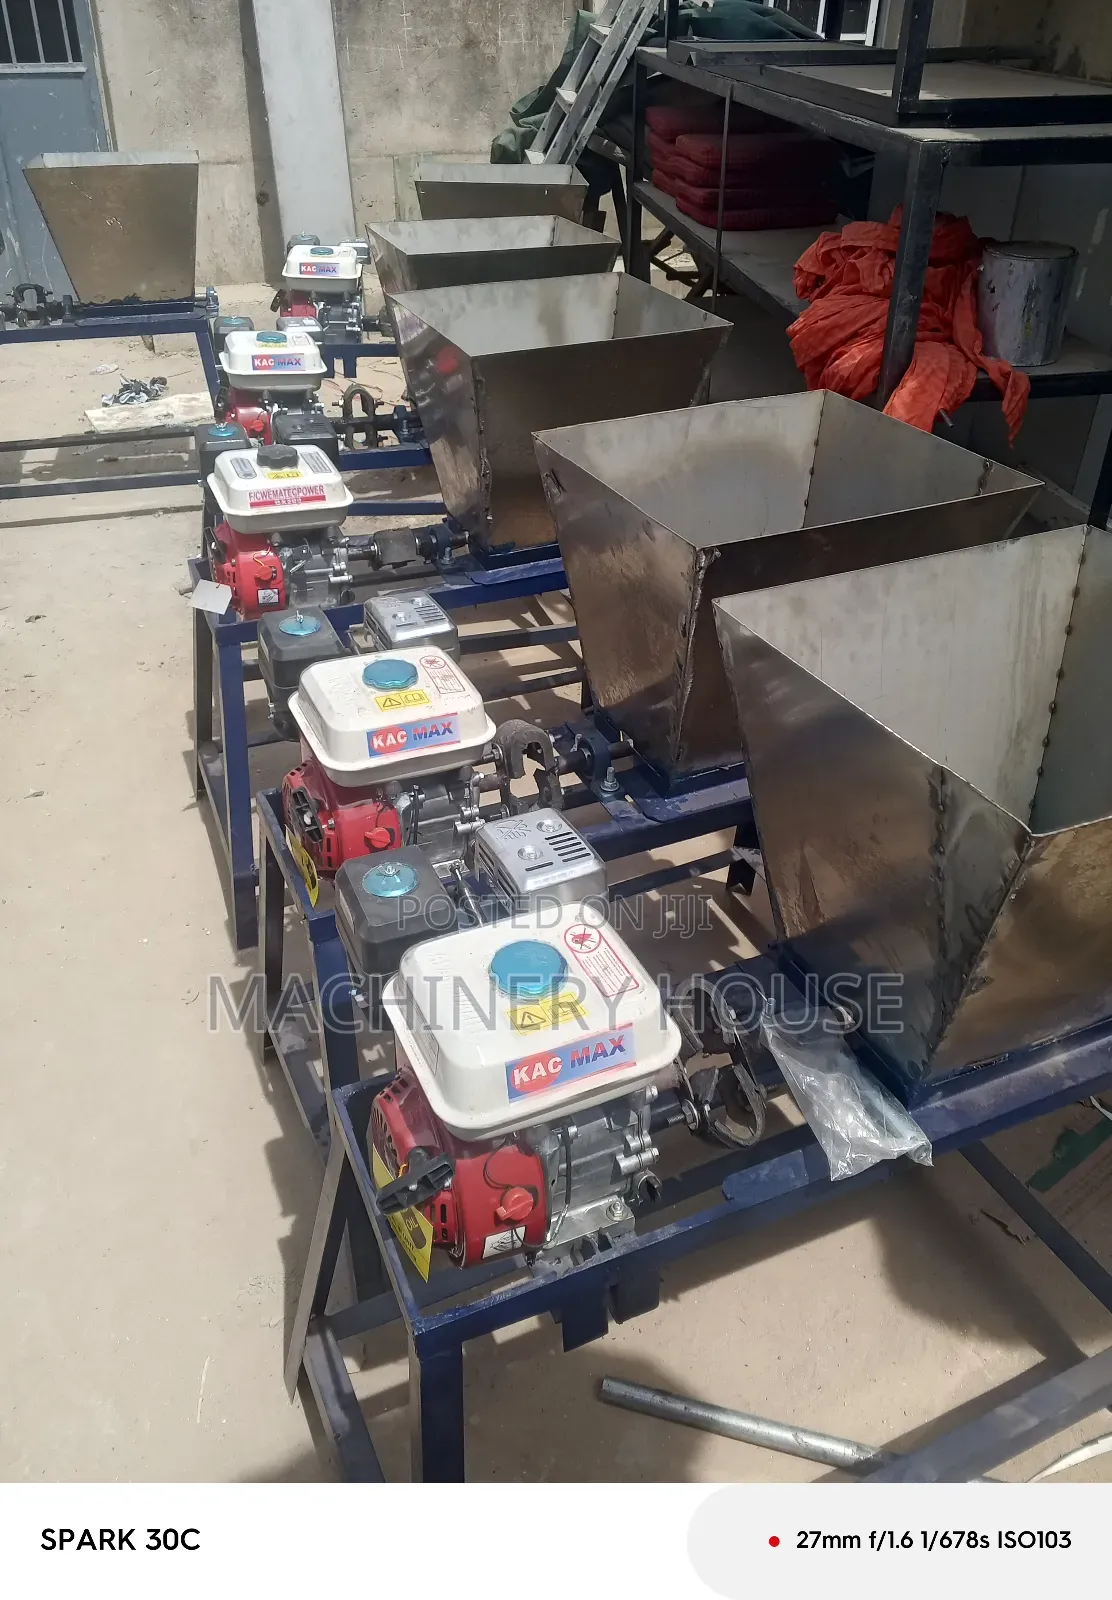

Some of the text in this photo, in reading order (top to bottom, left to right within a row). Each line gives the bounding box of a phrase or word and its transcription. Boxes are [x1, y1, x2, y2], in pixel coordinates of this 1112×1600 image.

[319, 265, 337, 273] MAX
[254, 357, 302, 367] KAC MAX
[372, 721, 453, 750] KAC MAX
[513, 1034, 627, 1086] KAC MAX
[405, 1217, 419, 1231] OIL
